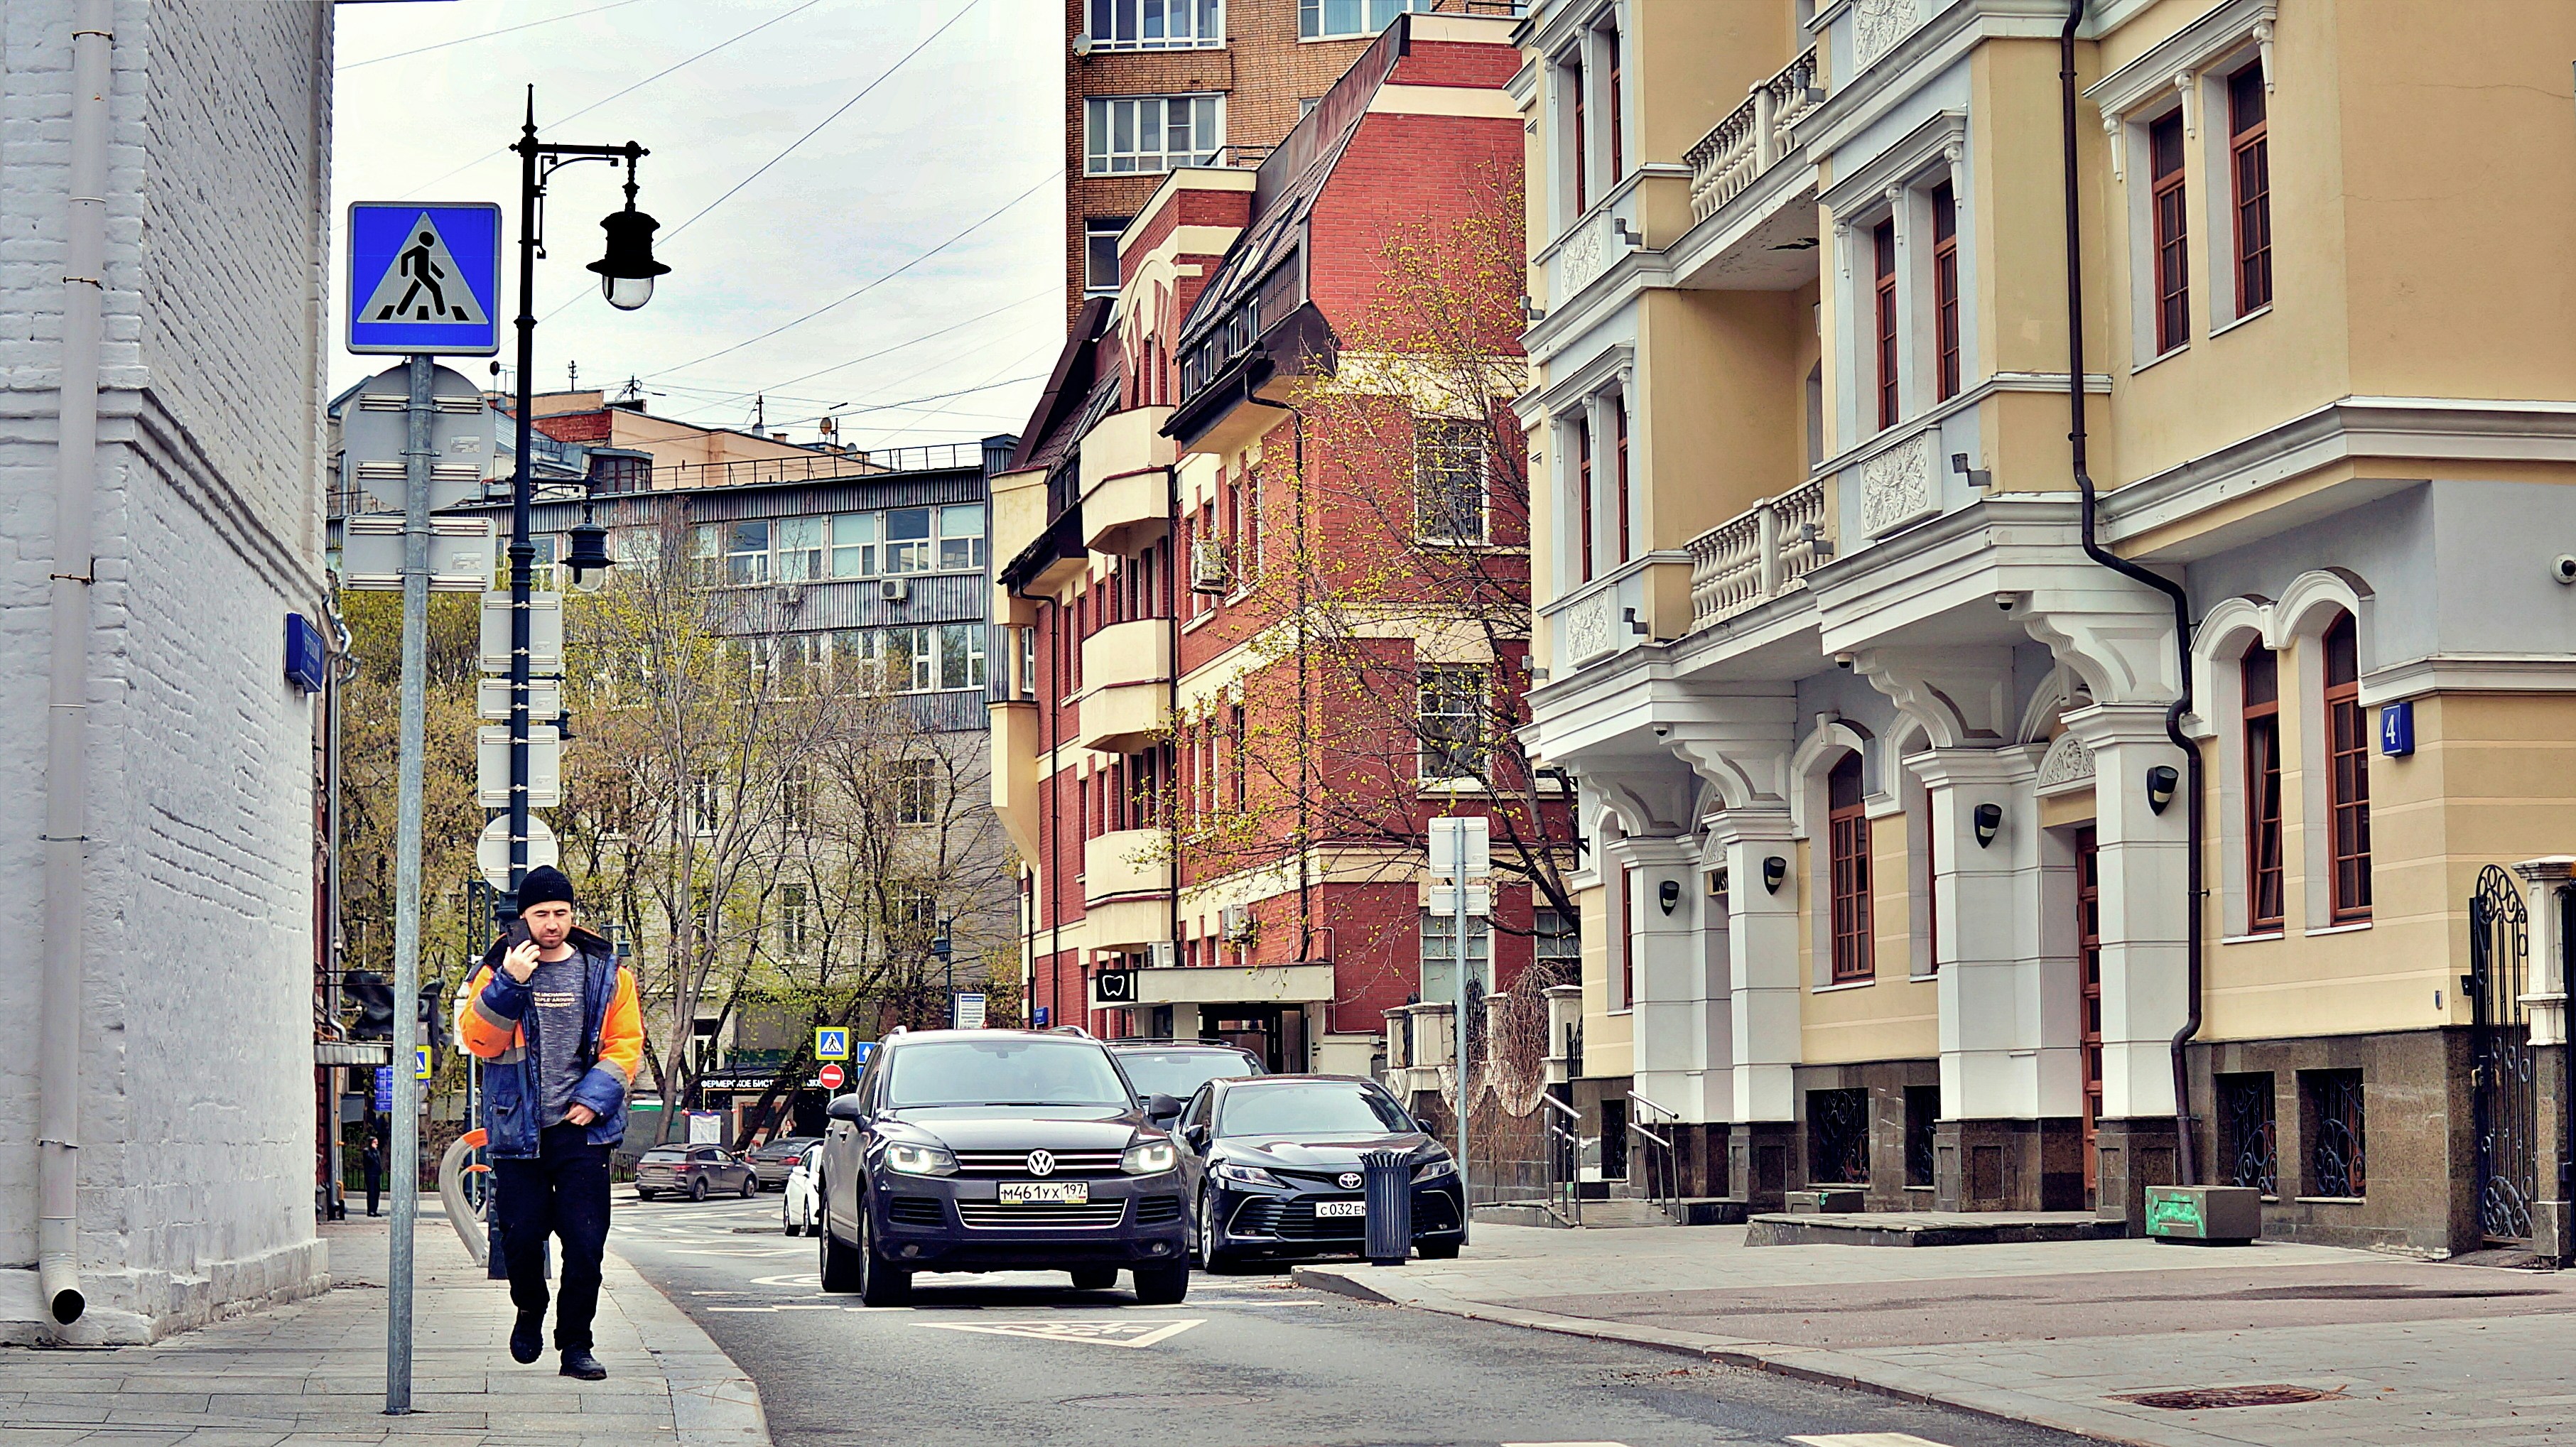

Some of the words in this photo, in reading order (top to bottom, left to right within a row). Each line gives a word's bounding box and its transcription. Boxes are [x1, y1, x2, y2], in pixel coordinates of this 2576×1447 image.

[2386, 714, 2396, 744] 4
[752, 1079, 774, 1088] БИСТ
[1064, 1183, 1083, 1194] 197
